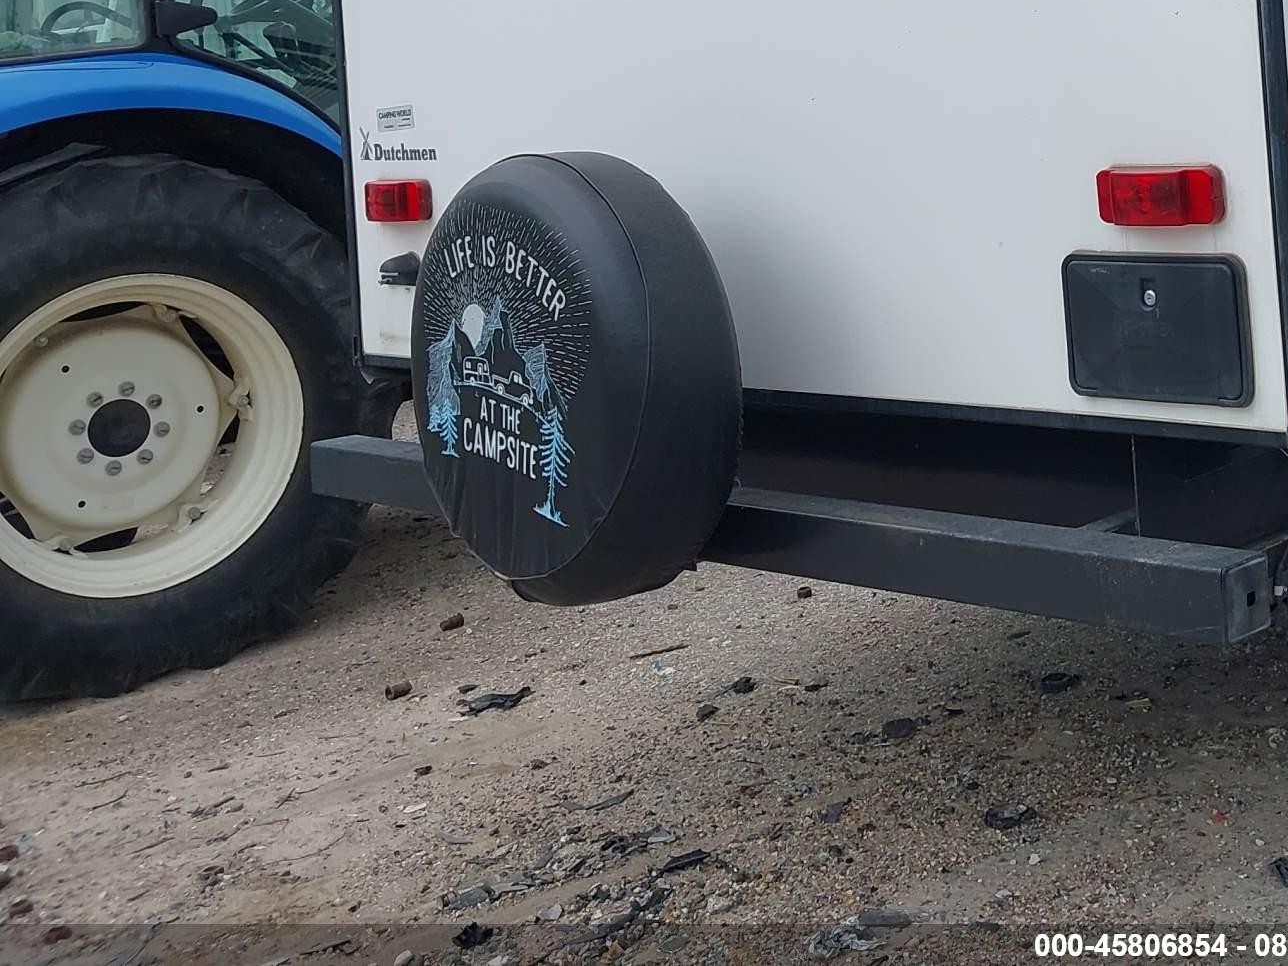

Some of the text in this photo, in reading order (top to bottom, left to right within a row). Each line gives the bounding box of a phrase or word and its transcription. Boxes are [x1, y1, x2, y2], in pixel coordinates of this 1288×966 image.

[373, 142, 437, 161] Dutchmen
[444, 235, 566, 322] LIFE IS BETTER
[480, 396, 521, 435] AT THE
[463, 417, 538, 480] CAMPSITE
